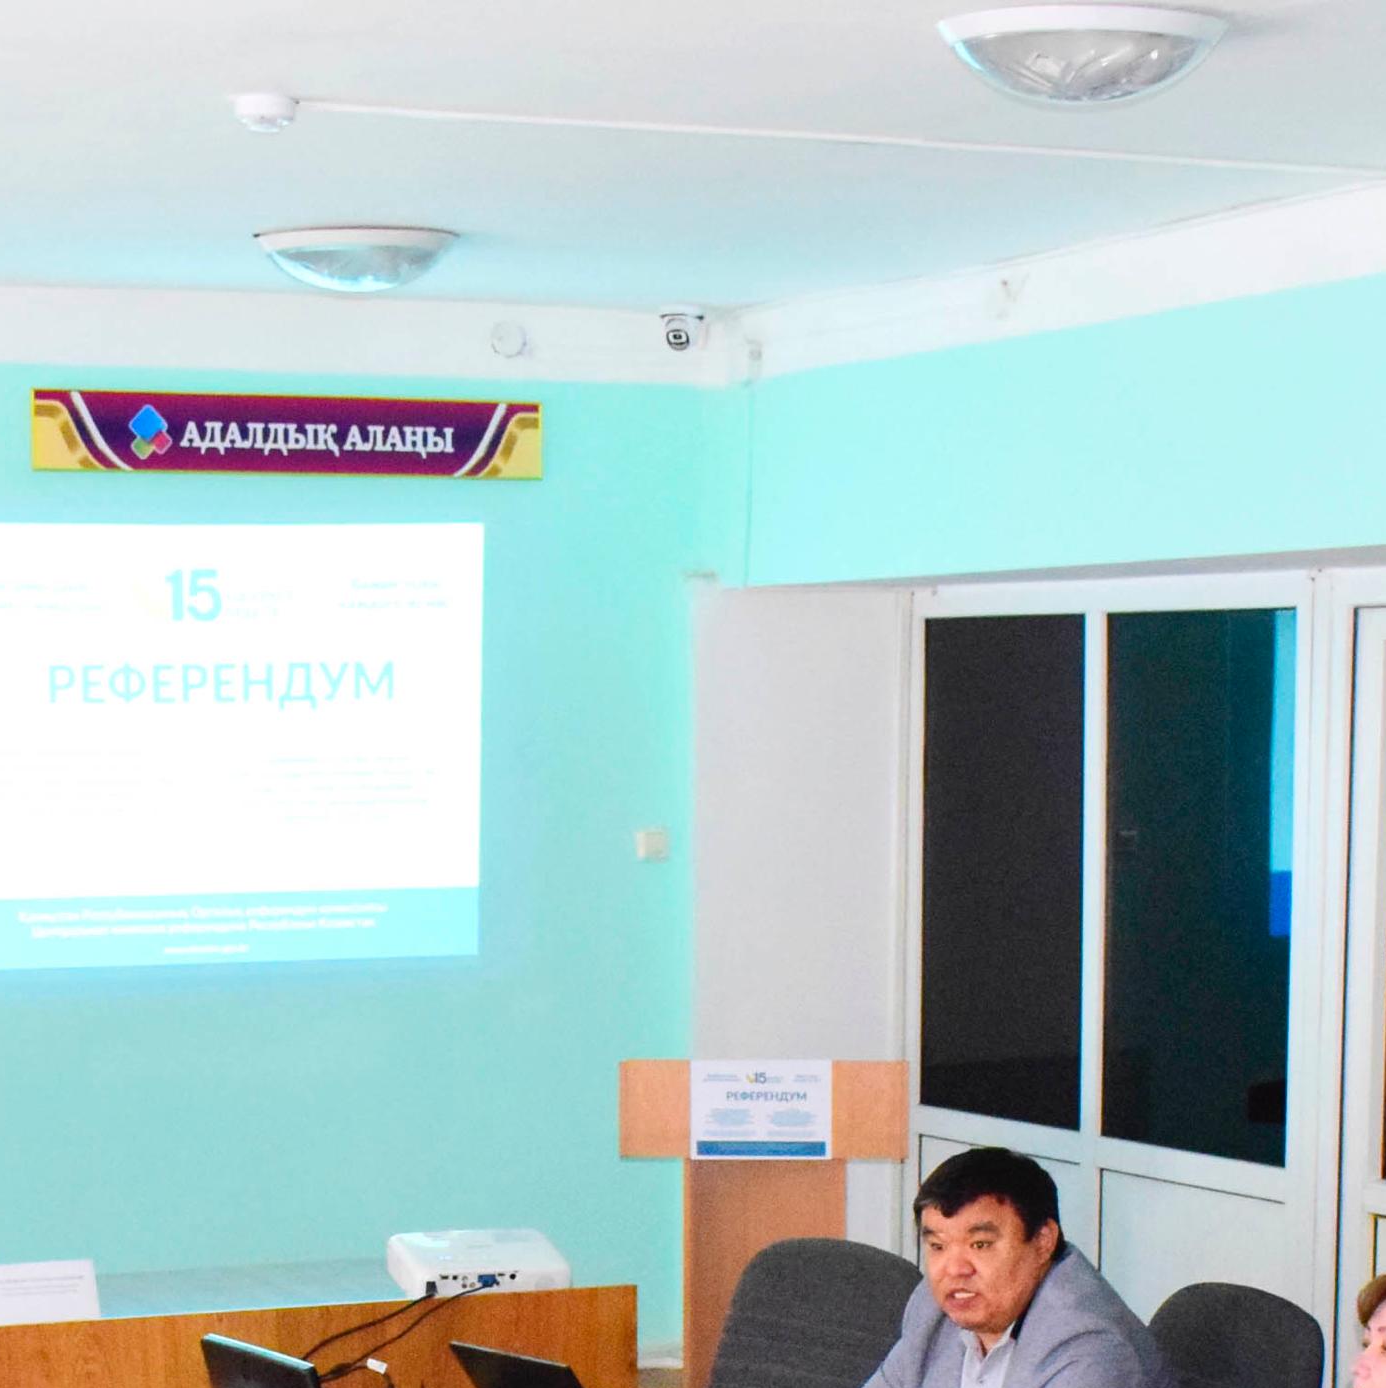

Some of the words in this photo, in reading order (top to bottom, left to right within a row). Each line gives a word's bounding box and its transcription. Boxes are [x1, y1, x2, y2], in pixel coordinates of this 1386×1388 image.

[180, 421, 340, 456] АДАЛДЫҚ
[343, 426, 454, 458] АЛАҢЫ
[165, 569, 223, 622] 15
[48, 661, 395, 710] РЕФЕРЕНДУМ
[726, 1091, 807, 1102] РЕФЕРЕНДУМ
